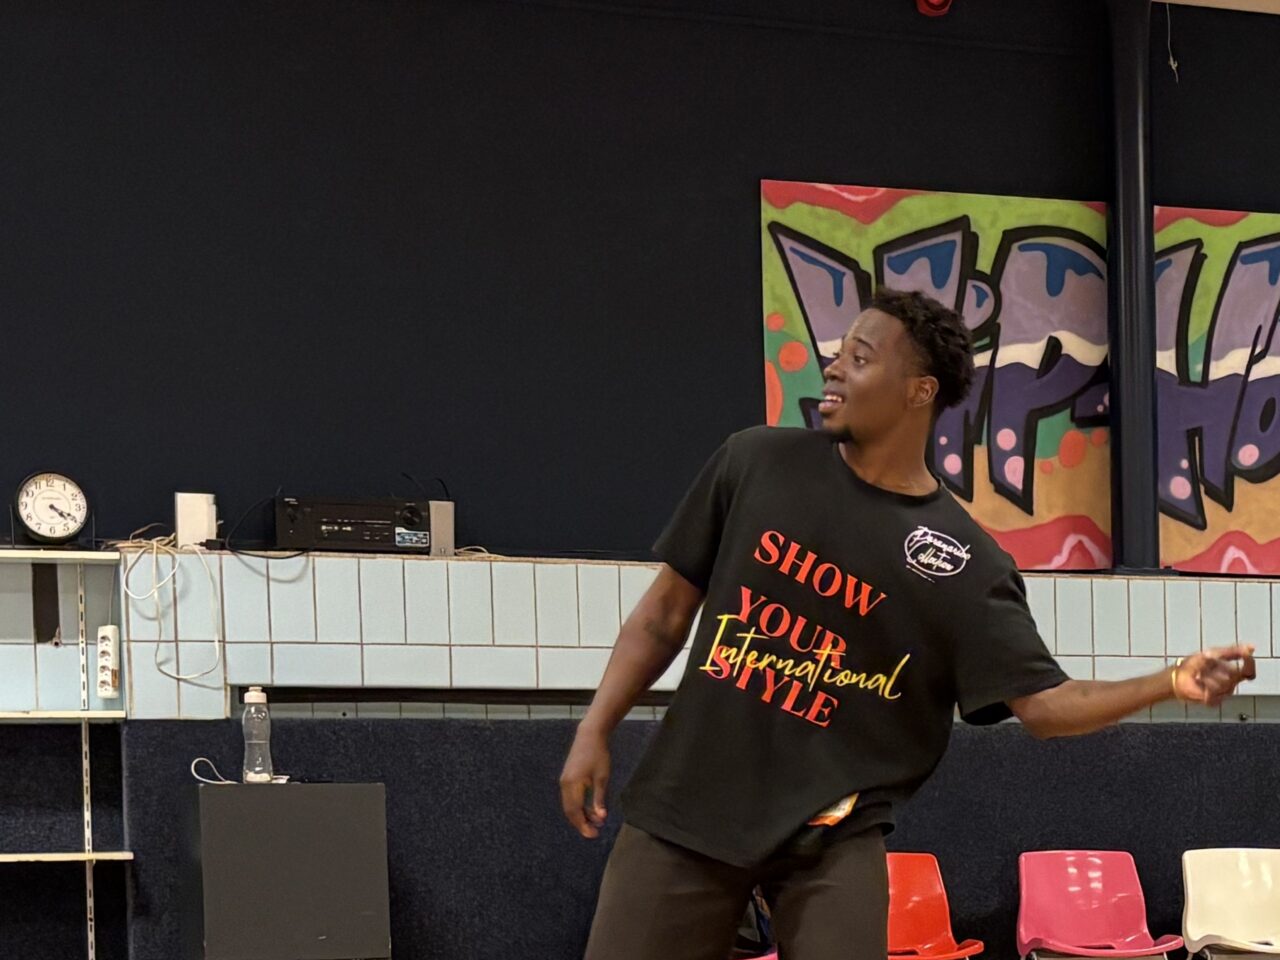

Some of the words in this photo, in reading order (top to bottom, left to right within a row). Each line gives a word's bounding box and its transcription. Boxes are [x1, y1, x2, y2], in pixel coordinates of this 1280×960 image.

[753, 530, 887, 617] SHOW
[699, 614, 911, 700] International
[738, 586, 847, 670] YOUR
[706, 645, 839, 728] STYLE
